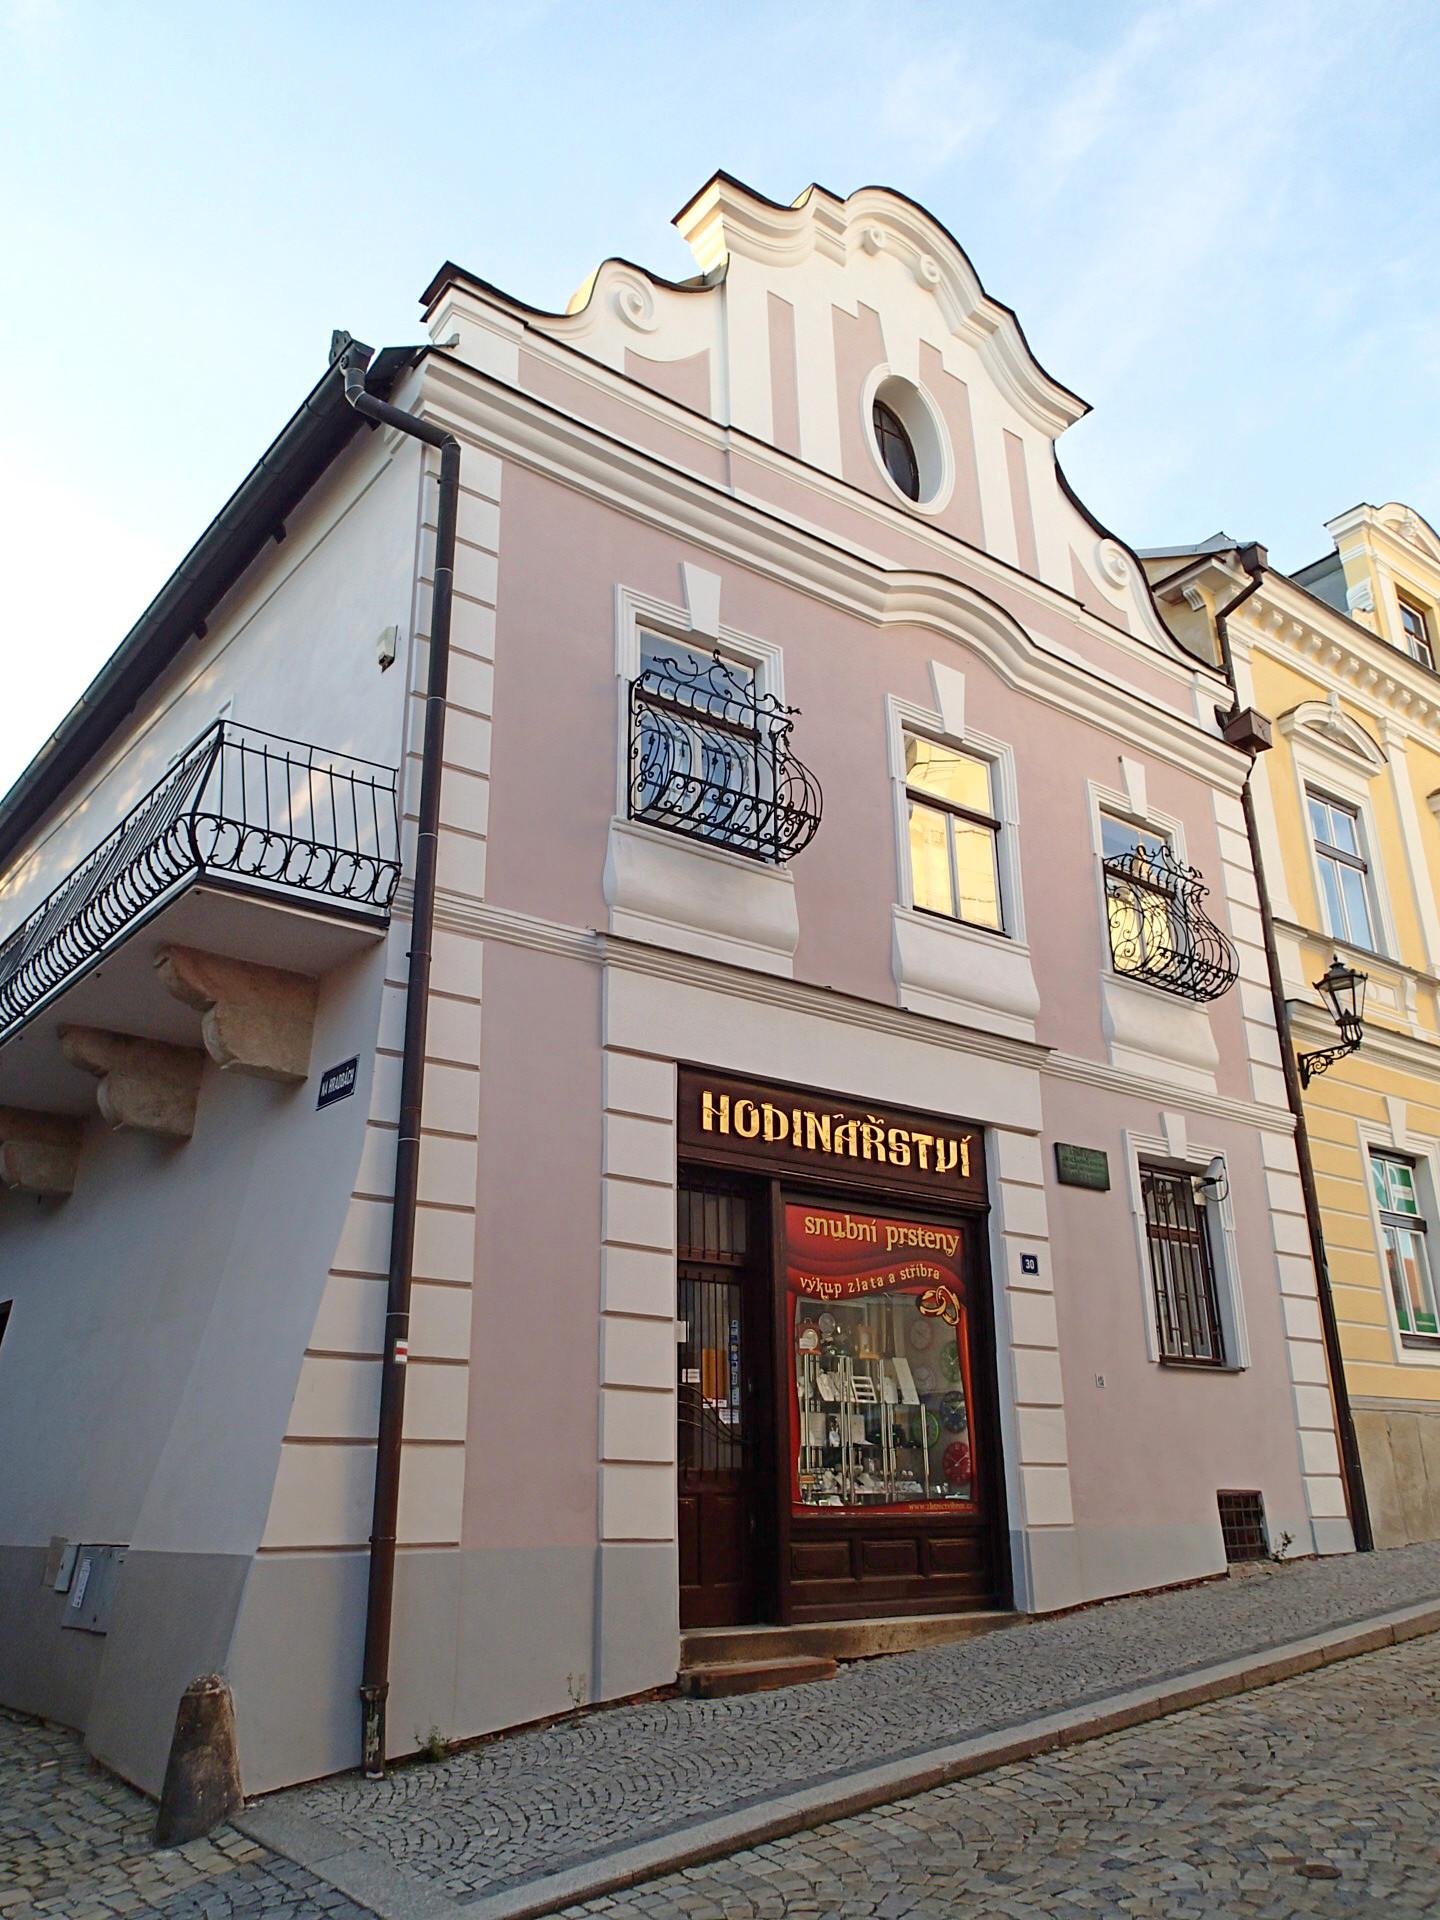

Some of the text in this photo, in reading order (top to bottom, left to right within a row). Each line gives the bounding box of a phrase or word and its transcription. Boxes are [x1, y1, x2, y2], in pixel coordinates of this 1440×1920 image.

[320, 1080, 329, 1097] NA
[702, 1090, 972, 1178] HODINÁŘSTVÍ
[804, 1215, 960, 1257] snubní prsteny
[800, 1263, 940, 1300] výkup zlata a stříbra
[1025, 1258, 1035, 1270] 30
